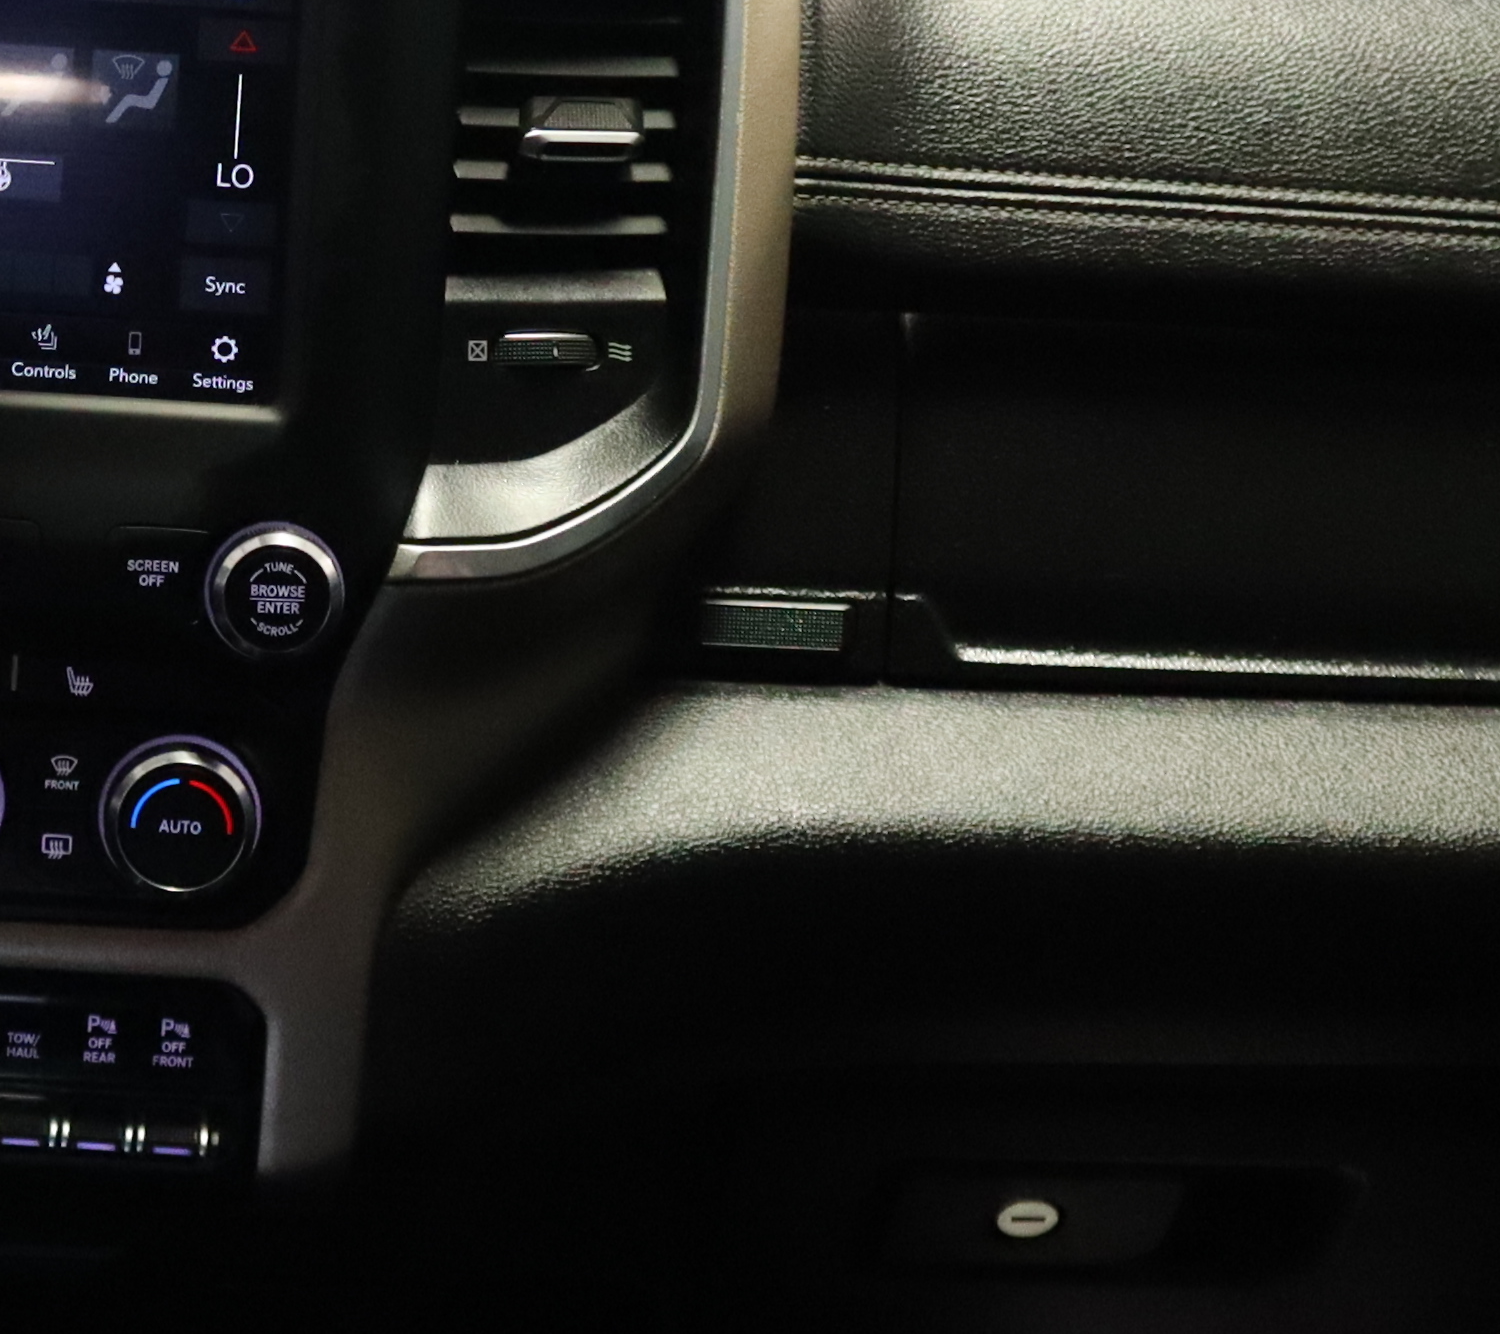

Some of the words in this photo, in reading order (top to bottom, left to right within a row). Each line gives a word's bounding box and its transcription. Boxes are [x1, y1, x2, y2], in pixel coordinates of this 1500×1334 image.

[216, 162, 255, 190] LO
[204, 275, 247, 297] Sync
[10, 362, 77, 381] Controls
[108, 367, 159, 385] Phone
[192, 372, 254, 393] Settings
[127, 559, 180, 574] SCREEN
[263, 561, 295, 576] TUNE
[138, 574, 165, 588] OFF
[250, 584, 306, 599] BROWSE
[257, 601, 300, 615] ENTER
[257, 622, 299, 637] SCROLL
[44, 779, 81, 792] FRONT
[158, 819, 202, 835] AUTO
[7, 1031, 41, 1046] TOW/
[88, 1037, 113, 1050] OFF
[6, 1046, 40, 1059] HAUL
[161, 1041, 187, 1054] OFF
[83, 1051, 116, 1064] REAR
[152, 1055, 194, 1069] FRONT
